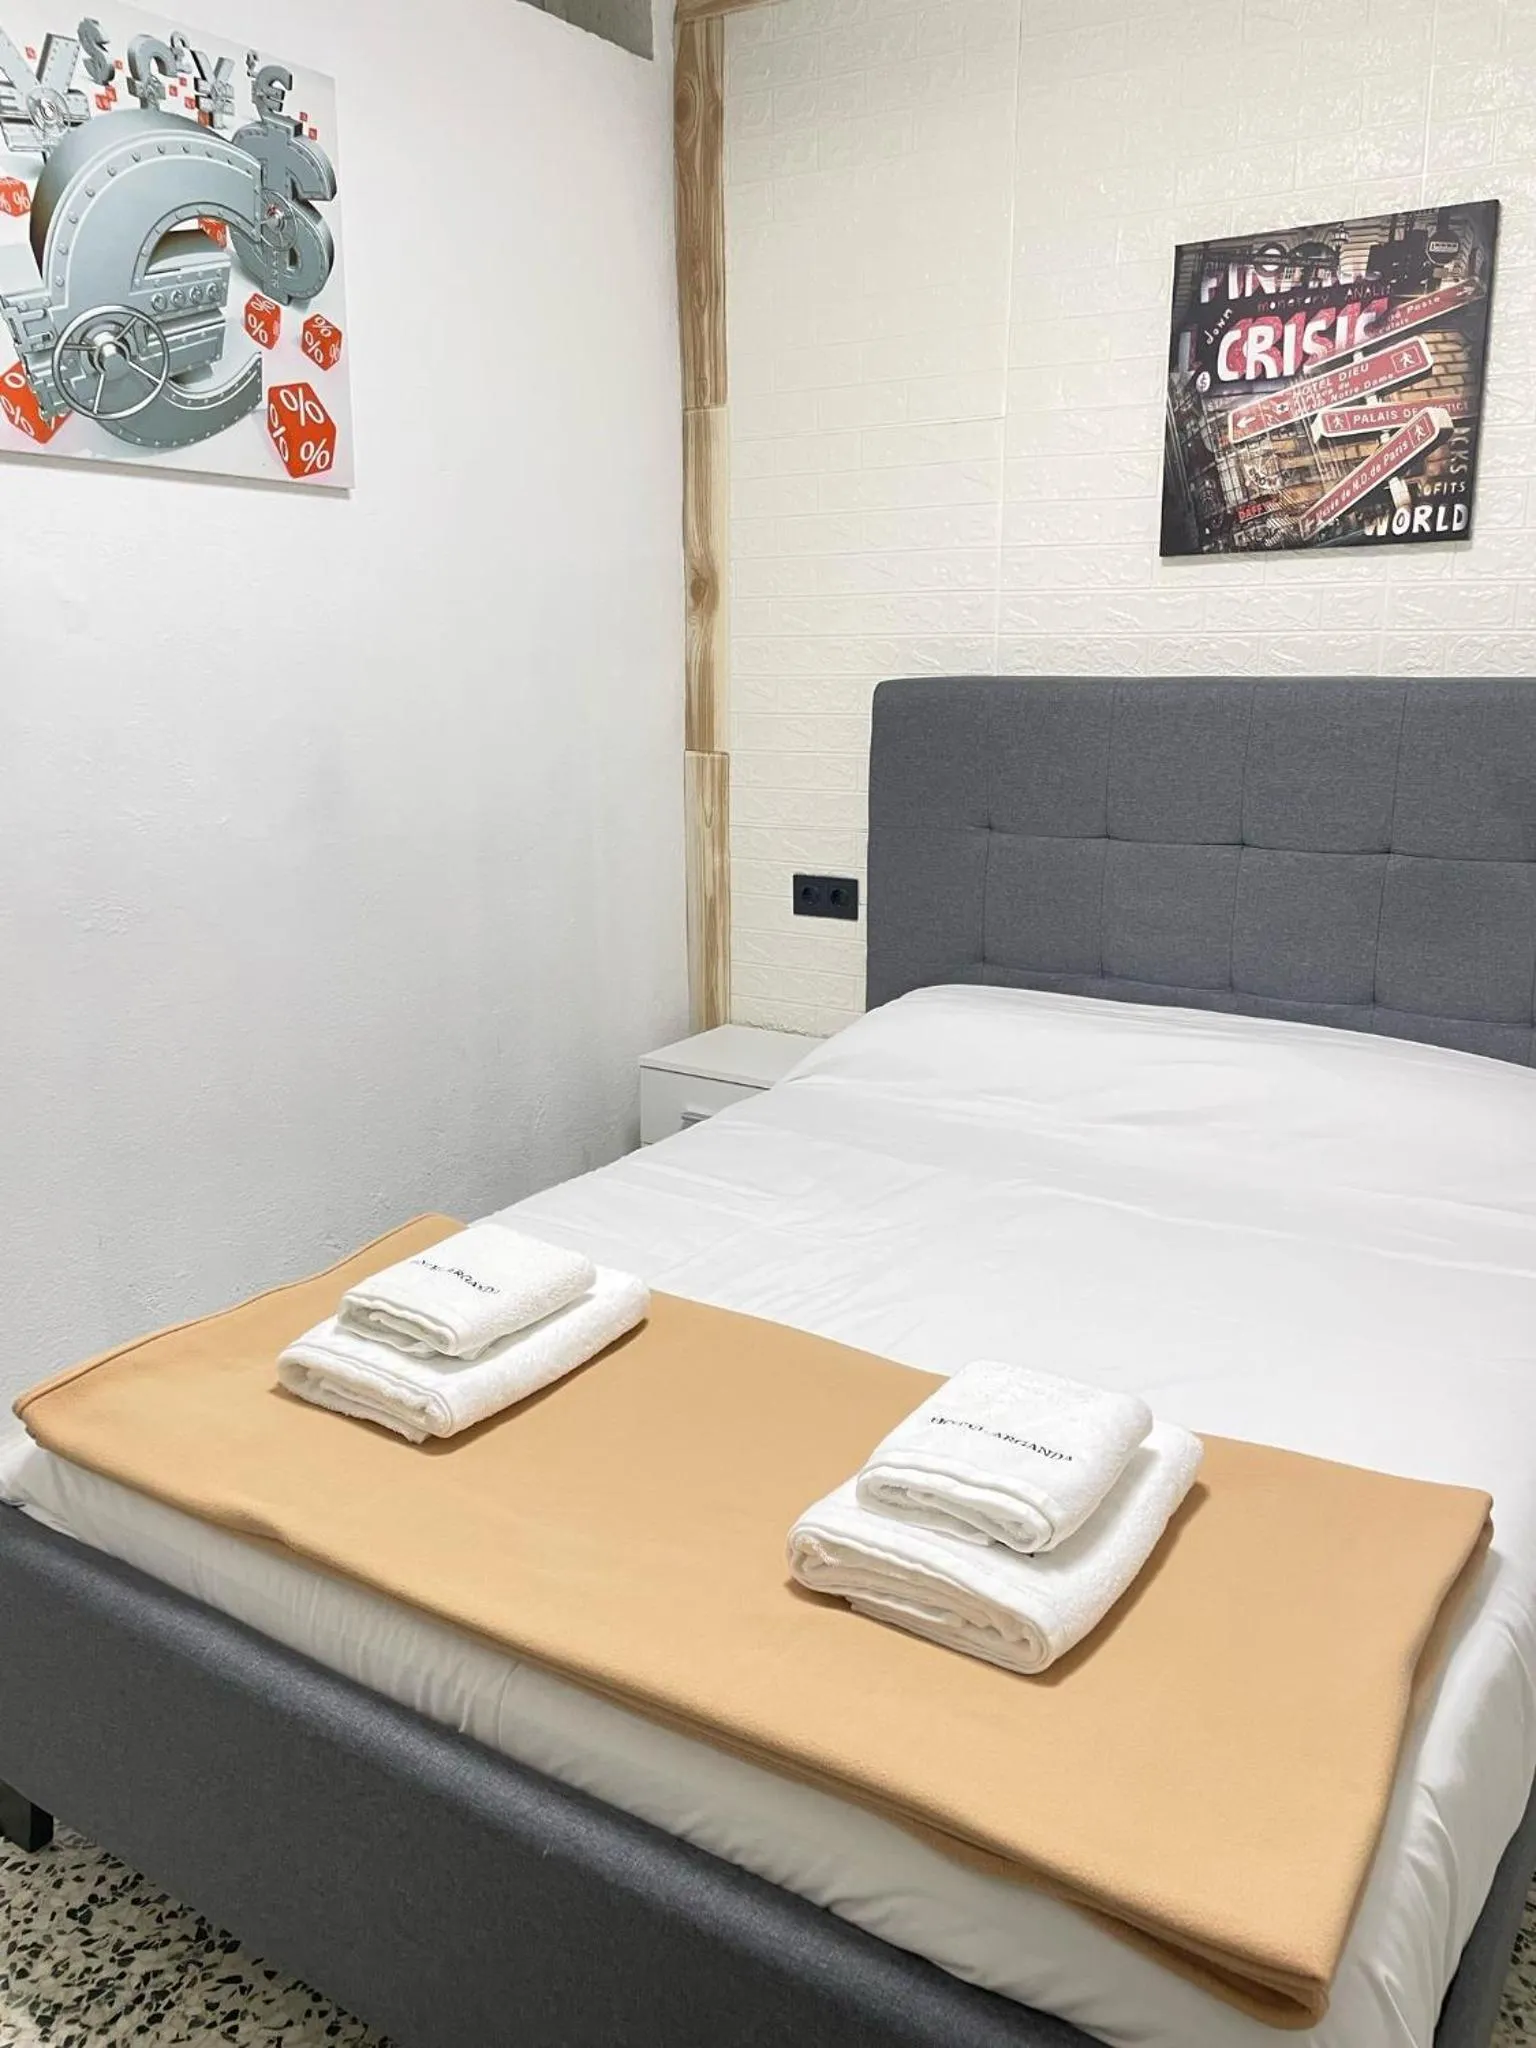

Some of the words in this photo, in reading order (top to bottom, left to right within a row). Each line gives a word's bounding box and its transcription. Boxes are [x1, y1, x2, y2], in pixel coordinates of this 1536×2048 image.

[1339, 363, 1370, 381] DIEU
[1364, 373, 1394, 389] Dame
[1352, 410, 1398, 424] PALAIS
[1383, 440, 1409, 466] Paris
[1364, 503, 1469, 536] WORLD
[993, 1431, 1073, 1462] ARGANDA
